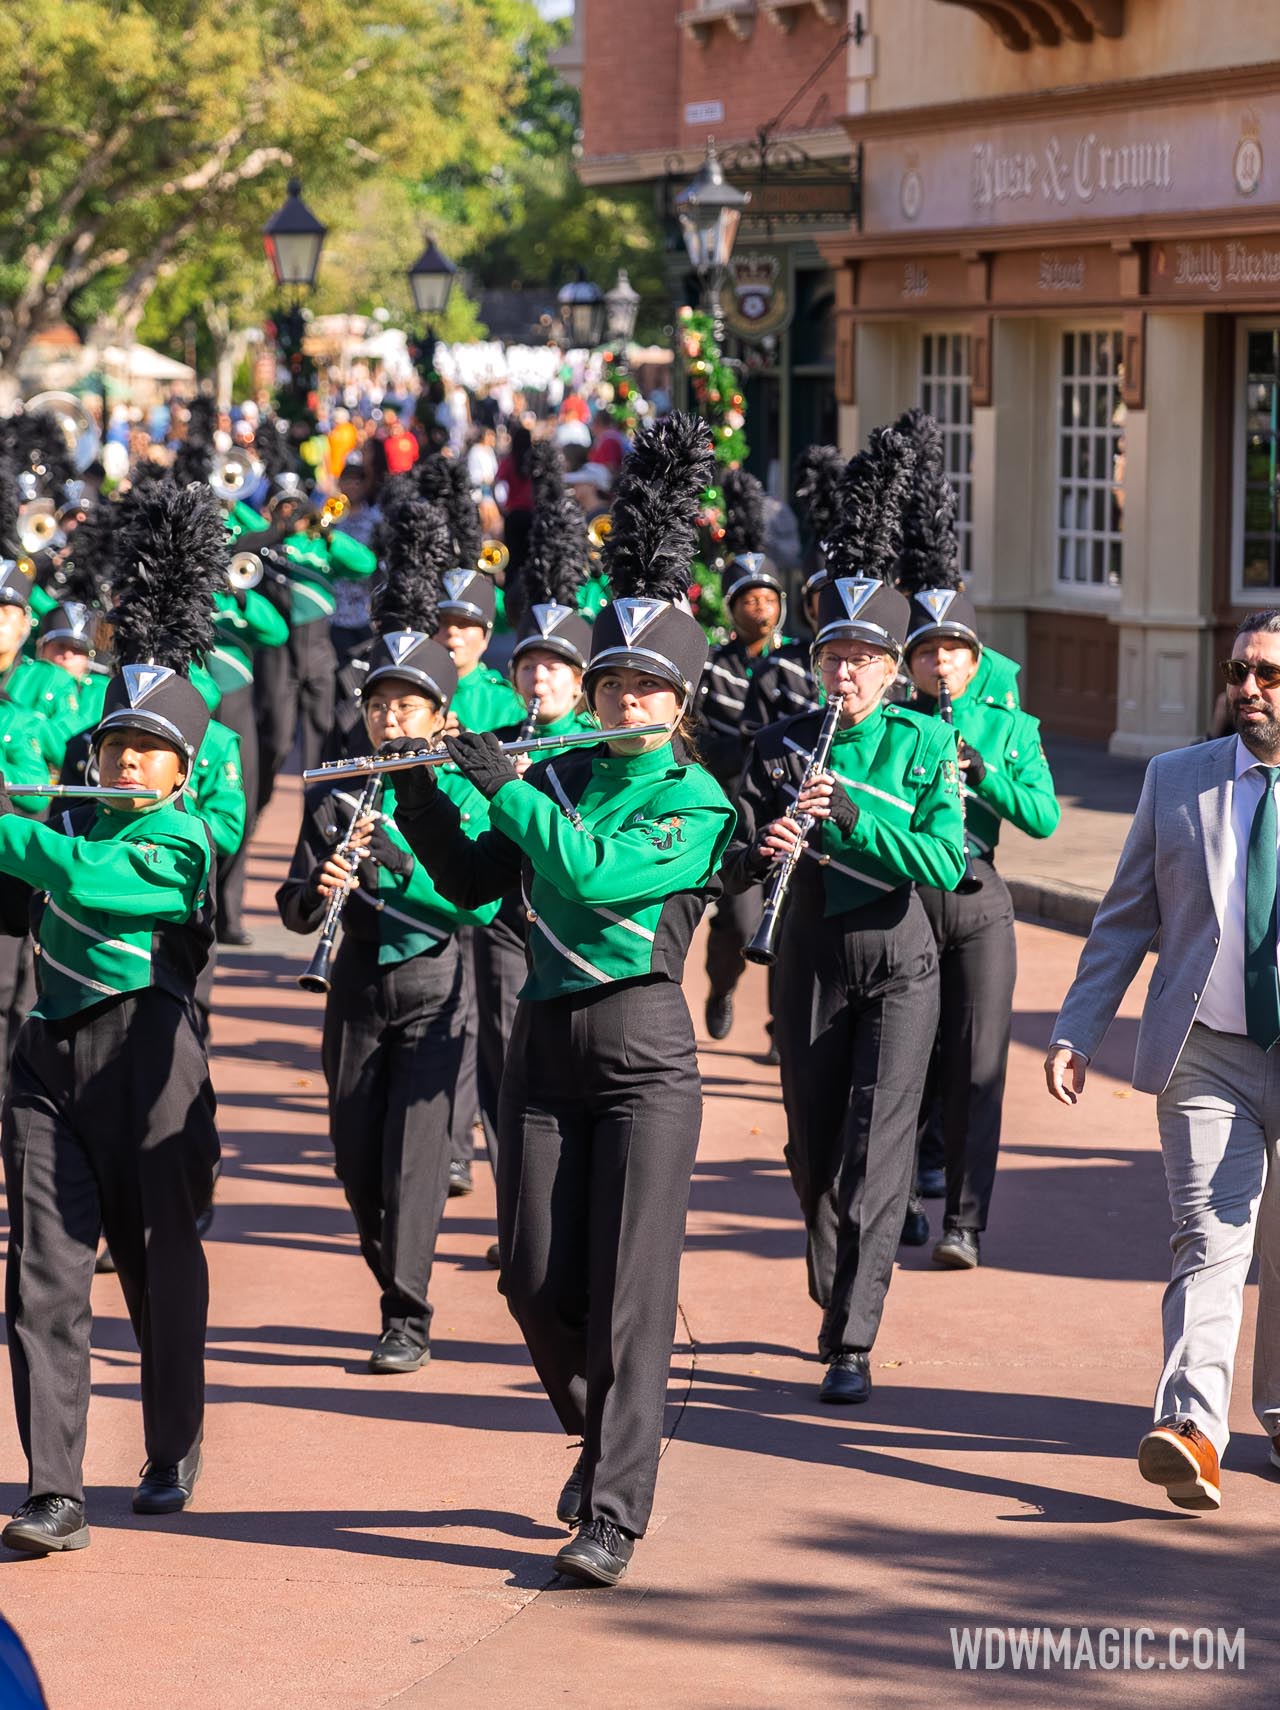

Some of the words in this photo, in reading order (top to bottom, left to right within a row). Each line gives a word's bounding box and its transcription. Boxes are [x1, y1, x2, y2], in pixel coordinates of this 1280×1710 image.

[972, 143, 1037, 203] Rose
[1041, 136, 1069, 201] &
[1073, 133, 1172, 200] Crown
